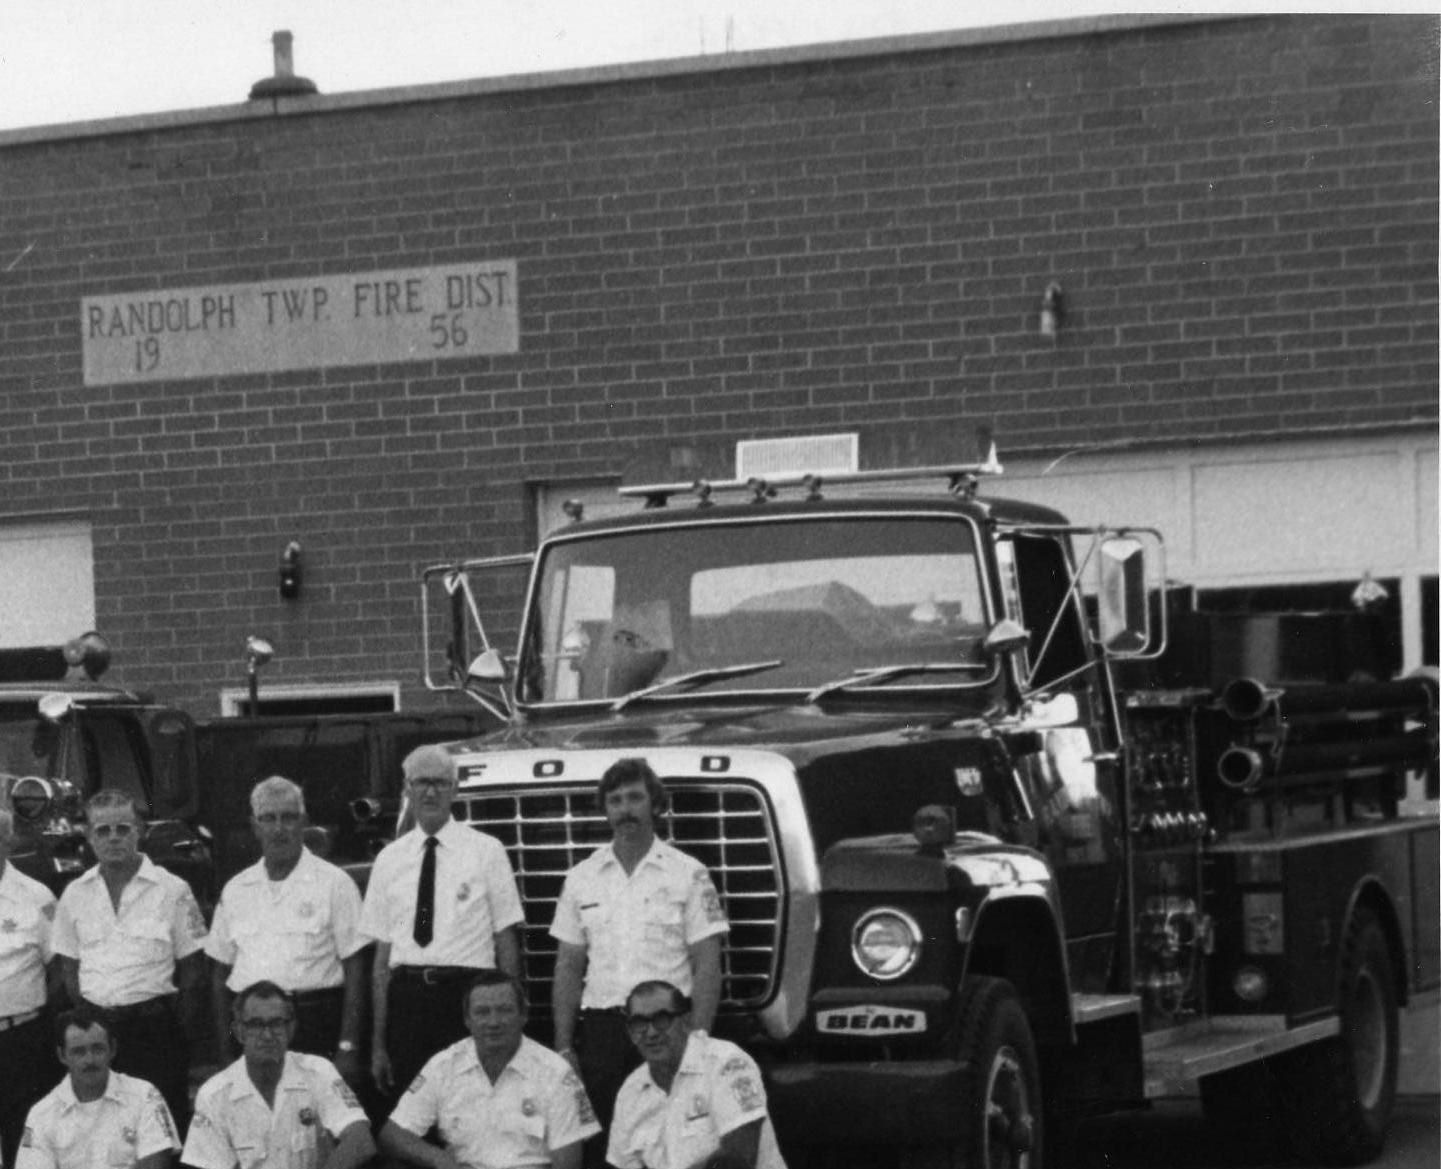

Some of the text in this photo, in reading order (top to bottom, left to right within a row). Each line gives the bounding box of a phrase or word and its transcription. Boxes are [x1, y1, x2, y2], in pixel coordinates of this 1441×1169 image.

[88, 294, 236, 339] RANDOLPH
[261, 287, 332, 325] TWP.
[353, 279, 424, 318] FIRE
[135, 313, 468, 373] 19 56
[458, 755, 731, 782] FOD
[825, 1014, 917, 1031] BEAN
